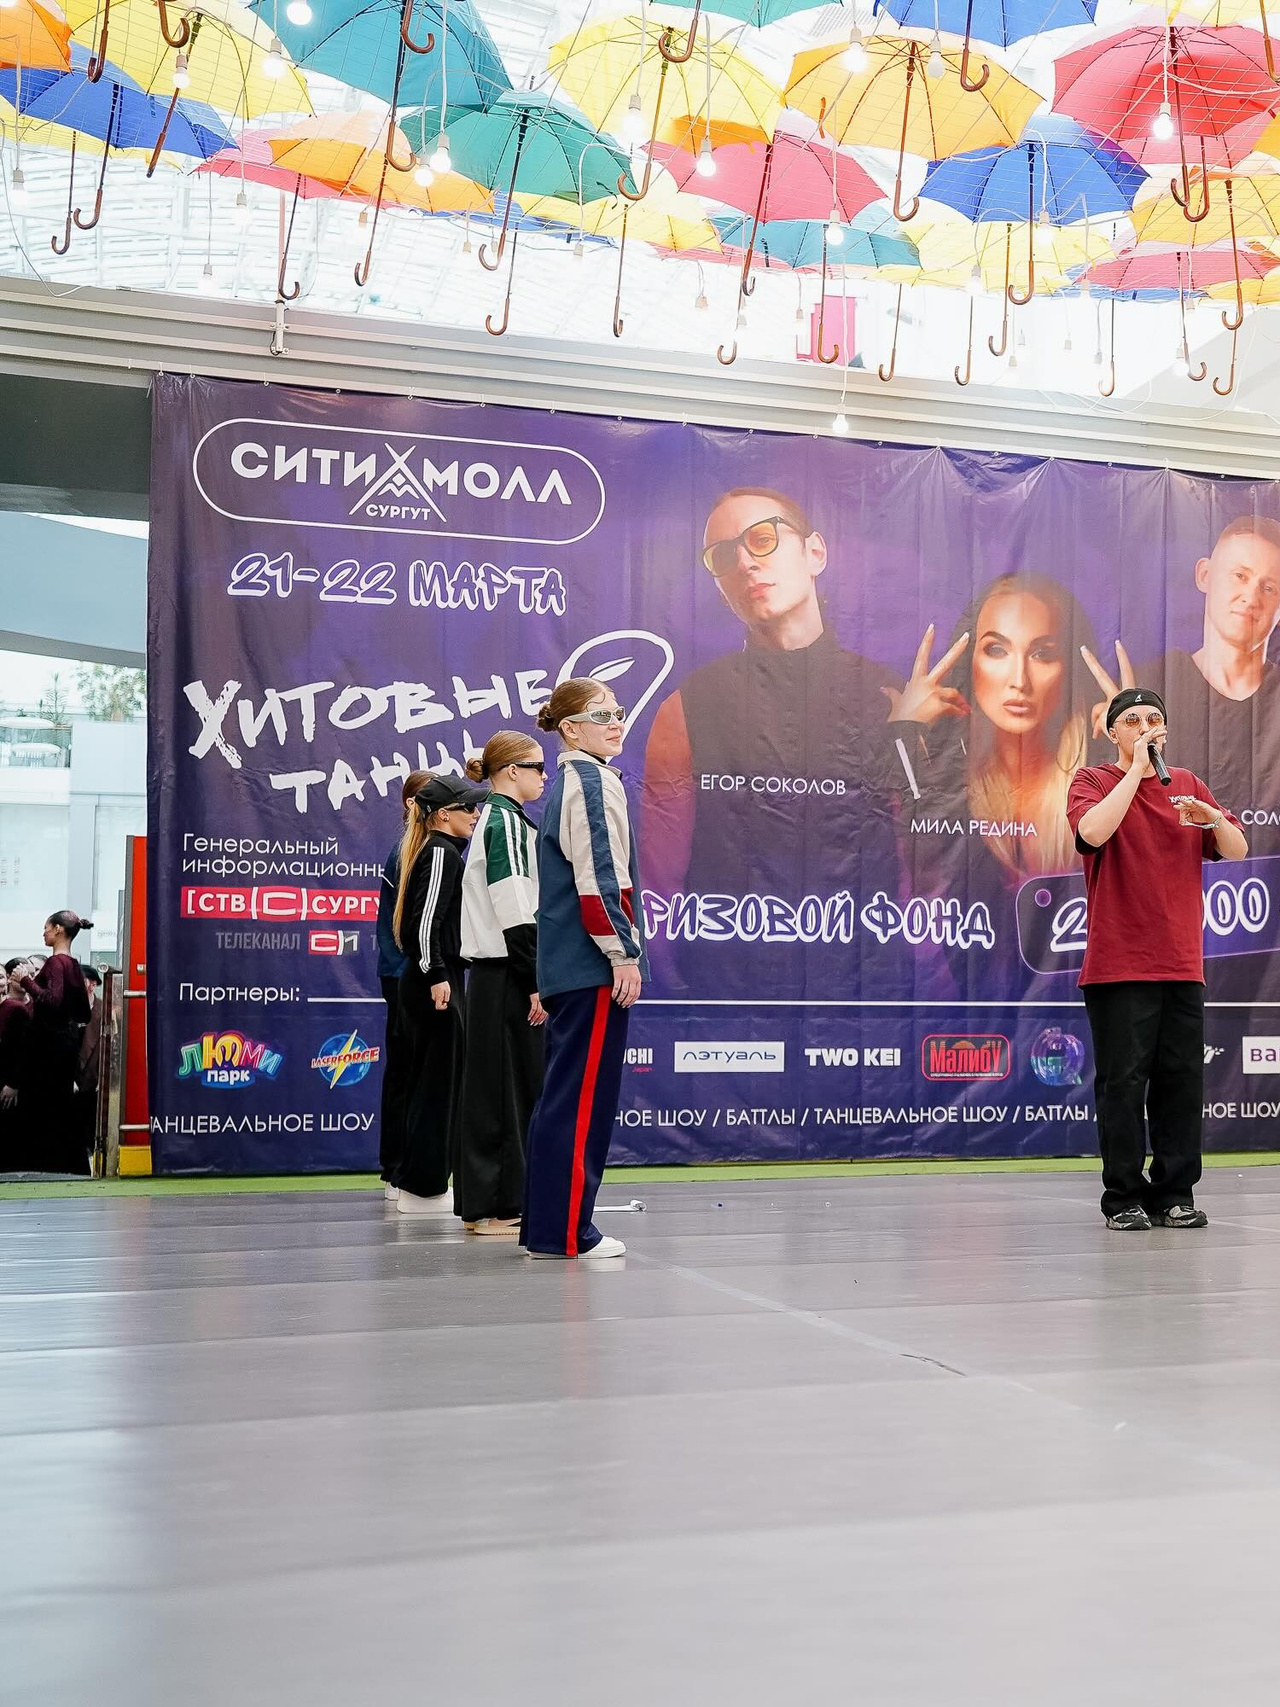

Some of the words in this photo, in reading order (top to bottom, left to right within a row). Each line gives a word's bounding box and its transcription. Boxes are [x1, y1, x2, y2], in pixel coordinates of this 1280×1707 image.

[231, 442, 376, 486] СИТИ
[423, 458, 572, 505] МОЛЛ
[365, 504, 430, 520] СУРГУТ
[227, 552, 397, 606] 21-22
[409, 559, 566, 616] МАРТА
[700, 774, 745, 790] ЕГОР
[751, 776, 846, 796] СОКОЛОВ
[911, 818, 964, 835] МИЛА
[969, 819, 1037, 837] РЕДИНА
[183, 833, 338, 857] Генеральный
[860, 891, 995, 950] ФОНД
[216, 932, 300, 949] ТЕЛЕКАНАЛ
[179, 983, 300, 1004] Партнеры:
[805, 1048, 859, 1066] TWO
[864, 1048, 900, 1066] KEI
[320, 1113, 375, 1131] ШОУ
[658, 1109, 707, 1126] ШОУ
[726, 1108, 795, 1126] БАТТЛЫ
[814, 1106, 958, 1127] ТАНЦЕВАЛЬНОЕ
[963, 1106, 1008, 1123] ШОУ
[1025, 1105, 1088, 1121] БАТТЛЫ
